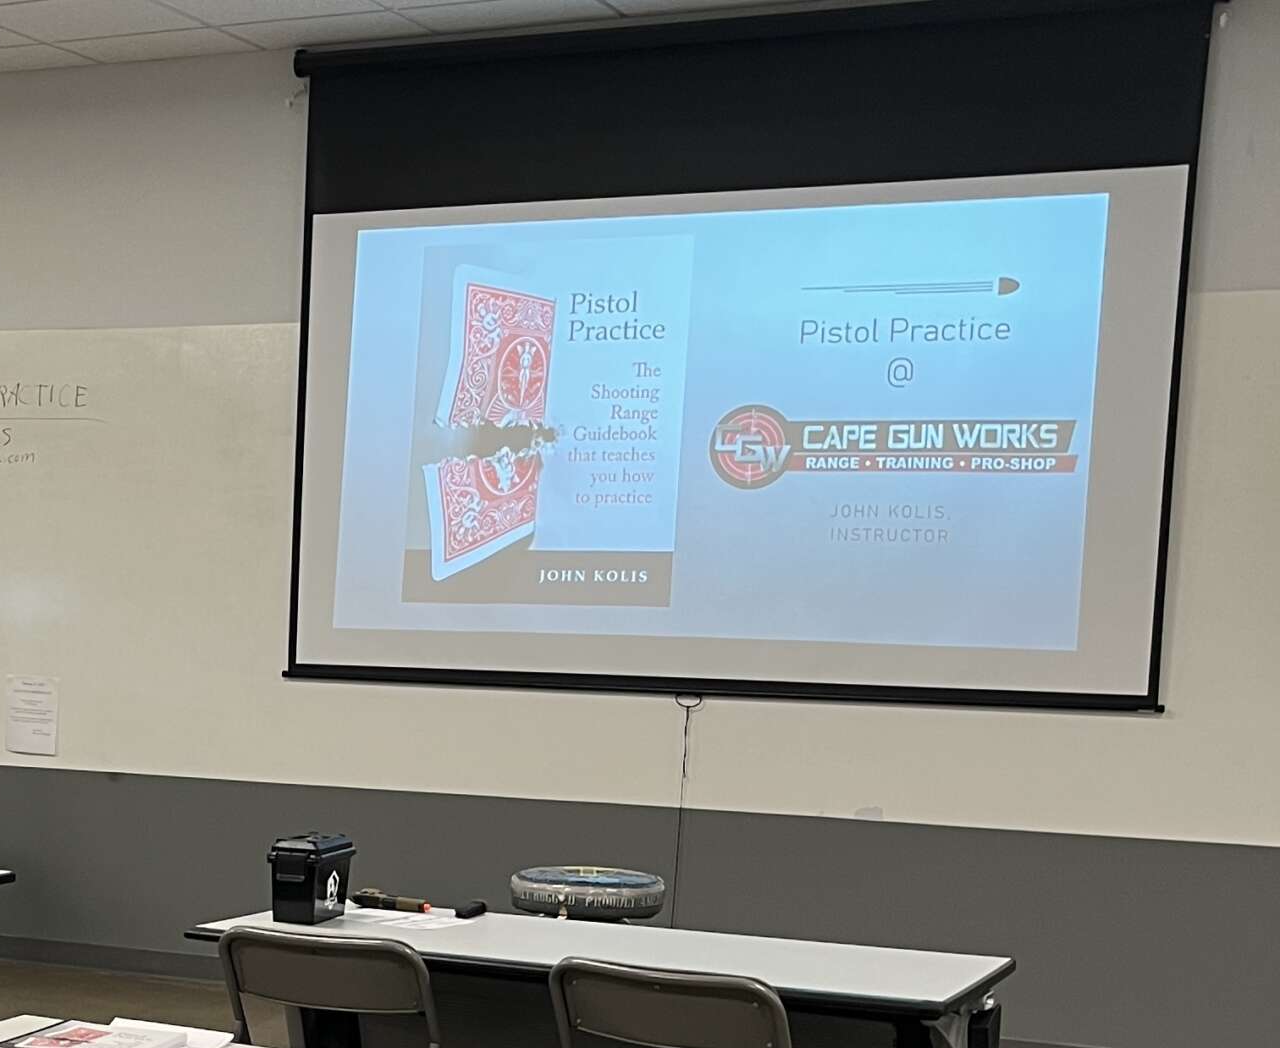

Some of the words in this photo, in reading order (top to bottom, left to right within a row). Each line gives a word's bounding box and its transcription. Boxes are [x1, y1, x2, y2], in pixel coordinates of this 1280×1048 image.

[569, 291, 639, 315] Pistol
[569, 318, 666, 342] Practice
[799, 317, 880, 345] Pistol
[889, 316, 1012, 342] Practice
[632, 362, 661, 378] The
[886, 357, 915, 388] @
[591, 384, 660, 402] Shooting
[610, 405, 659, 423] Range
[573, 425, 658, 442] Guidebook
[802, 424, 877, 450] CAPE
[887, 423, 945, 449] GUN
[952, 422, 1059, 449] WORKS
[568, 447, 597, 462] that
[601, 447, 656, 462] teaches
[805, 457, 860, 470] RANGE
[875, 456, 955, 470] TRAINING
[970, 456, 1057, 471] PRO-SHOP
[590, 470, 617, 486] you
[621, 468, 655, 484] how
[575, 490, 591, 504] to
[594, 489, 653, 508] practice
[830, 503, 880, 519] JOHN
[830, 526, 950, 544] INSTRUCTOR
[538, 568, 586, 584] JOHN
[593, 569, 649, 584] KOLIS
